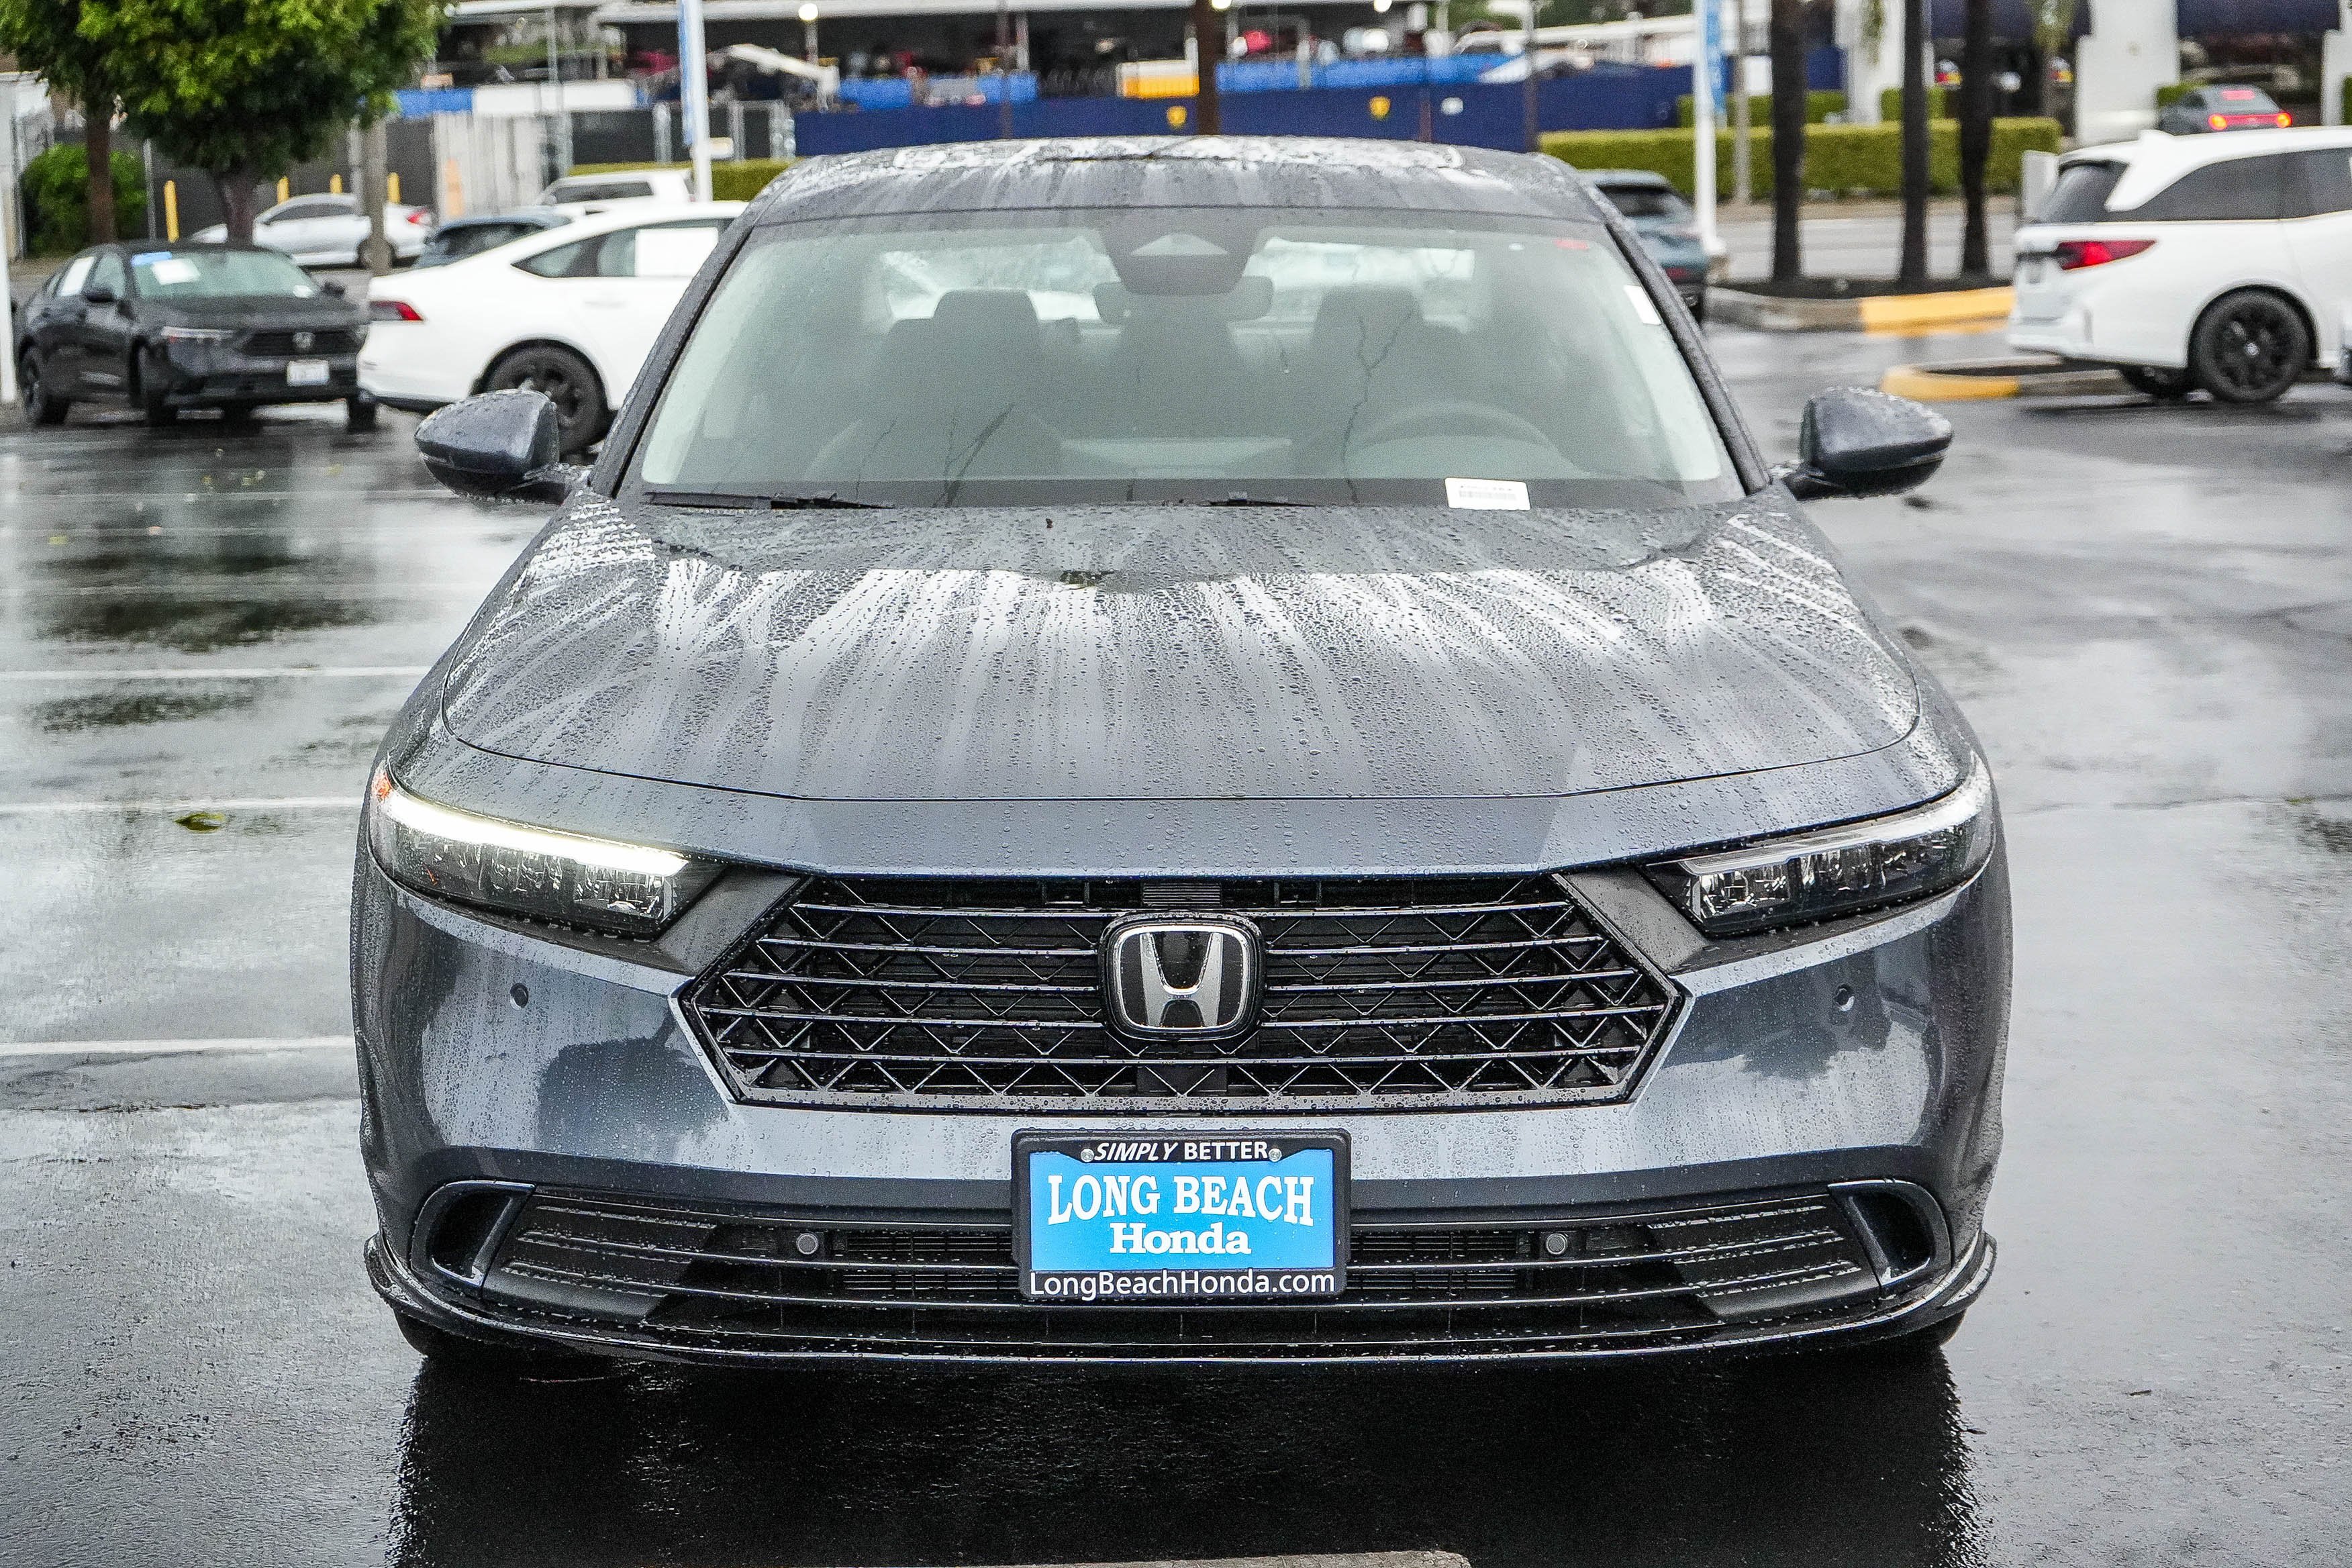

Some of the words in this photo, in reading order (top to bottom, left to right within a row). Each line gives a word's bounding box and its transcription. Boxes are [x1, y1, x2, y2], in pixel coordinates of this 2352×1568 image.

[1094, 1142, 1178, 1161] SIMPLY
[1184, 1141, 1269, 1161] BETTER
[1048, 1174, 1160, 1226] LONG
[1173, 1175, 1314, 1227] BEACH
[1110, 1222, 1252, 1254] Honda
[1030, 1269, 1335, 1301] LongBeachHonda.com
